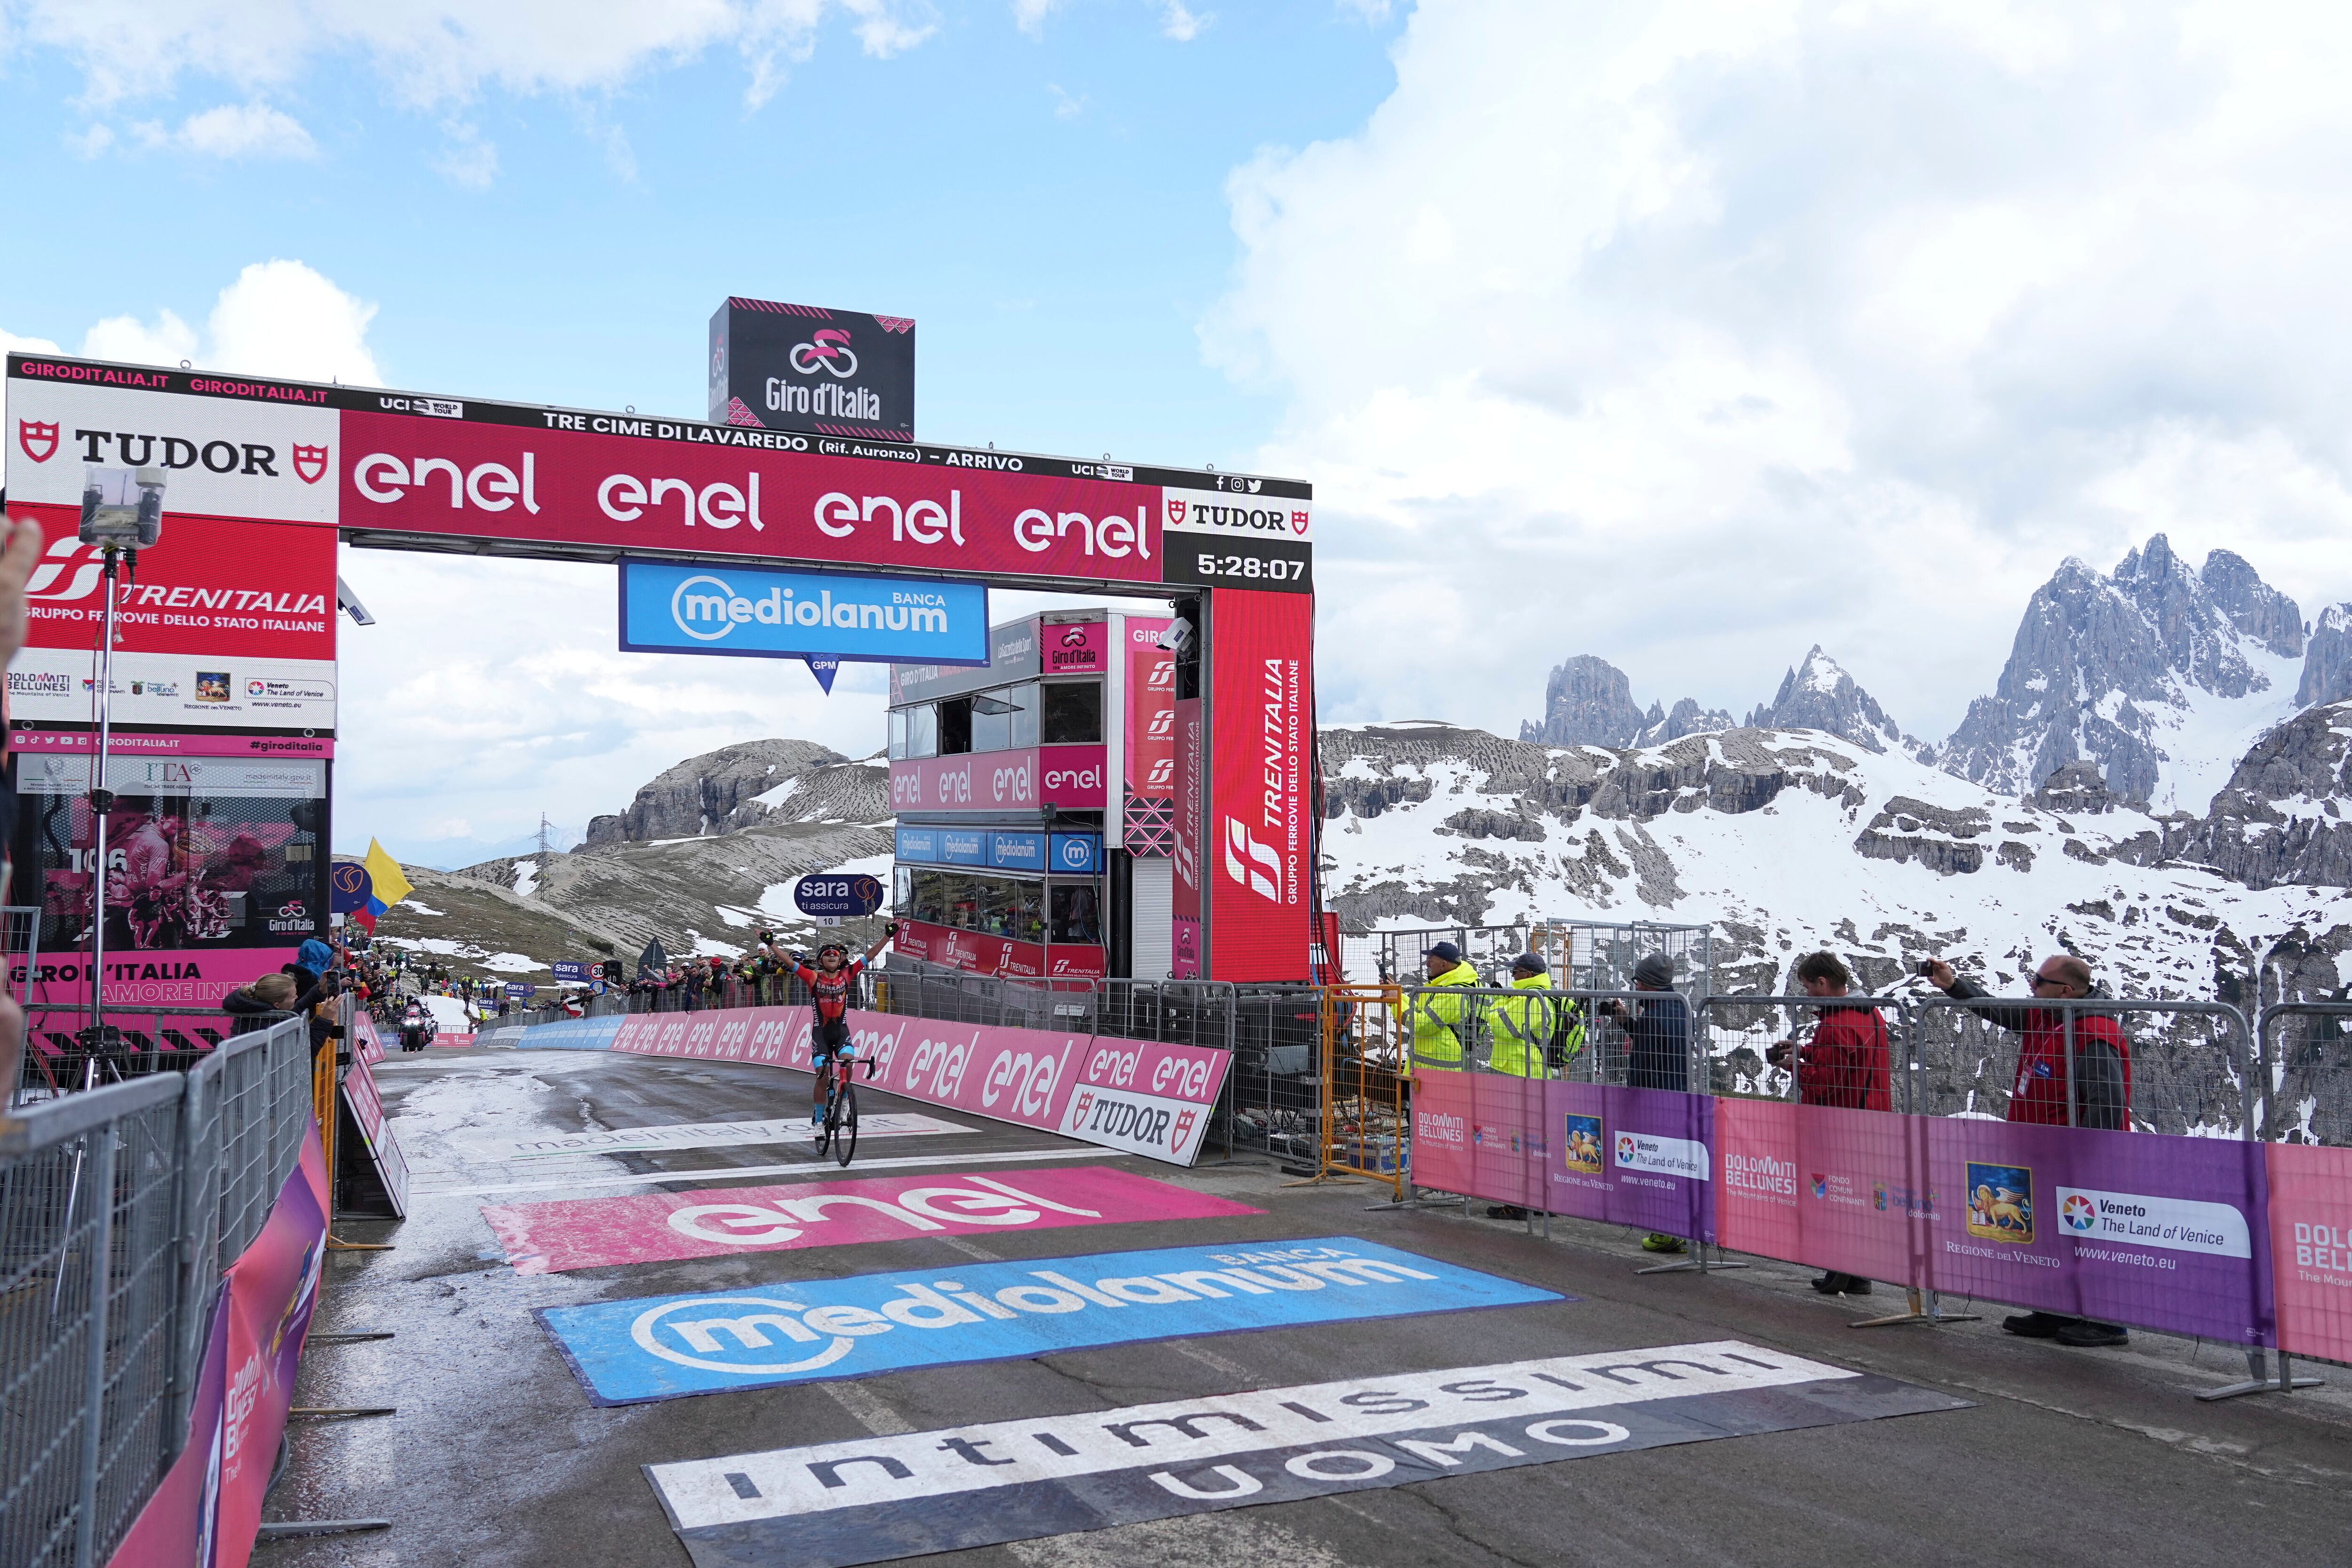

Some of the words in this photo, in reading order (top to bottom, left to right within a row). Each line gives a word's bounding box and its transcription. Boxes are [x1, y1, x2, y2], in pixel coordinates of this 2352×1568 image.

[21, 361, 169, 387] GIRODITALIA.IT
[191, 379, 327, 403] GIRODITALIA.IT
[380, 398, 410, 411] UCI
[766, 377, 810, 415] Giro
[813, 382, 880, 421] d'Italia
[75, 429, 279, 477] TUDOR
[543, 413, 586, 431] TRE
[592, 418, 652, 437] CIME
[658, 423, 682, 440] DI
[688, 425, 809, 452] LAVAREDO
[818, 440, 849, 455] (Rif.
[853, 444, 922, 463] Auronzo)
[946, 452, 1023, 471] ARRIVO
[1072, 464, 1094, 476] UCI
[354, 452, 541, 515] enel
[597, 472, 764, 532] enel
[814, 490, 965, 547] enel
[1193, 504, 1285, 531] TUDOR
[1014, 506, 1151, 560] enel
[1199, 555, 1304, 581] 5:28:07
[119, 584, 326, 614] TRENITALIA
[685, 587, 947, 633] mediolanum
[892, 592, 946, 607] BANCA
[165, 614, 209, 627] DELLO
[214, 617, 259, 630] STATO
[263, 619, 325, 633] ITALIANE
[1002, 641, 1015, 657] Gazzetta
[1023, 637, 1031, 654] Sport
[1053, 650, 1068, 664] Giro
[1070, 649, 1096, 663] d'Italia
[812, 661, 836, 670] GPM
[901, 670, 914, 687] GIRO
[914, 665, 938, 684] D'ITALIA
[1289, 660, 1298, 711] ITALIANE
[250, 741, 323, 751] #giroditalia
[1265, 659, 1282, 828] TRENITALIA
[1289, 715, 1298, 752] STATO
[894, 765, 921, 804] enel
[940, 761, 971, 803] enel
[993, 756, 1032, 802] enel
[1045, 764, 1101, 789] enel
[1289, 756, 1298, 791] DELLO
[1288, 796, 1298, 852] FERROVIE
[946, 838, 978, 854] mediolanum
[997, 840, 1035, 857] mediolanum
[801, 882, 848, 897] sara
[1288, 854, 1298, 904] GRUPPO
[270, 919, 286, 931] Giro
[288, 919, 314, 931] d'Italia
[908, 938, 926, 949] TRENITALIA
[955, 949, 976, 962] TRENITALIA
[1010, 962, 1035, 975] TRENITALIA
[817, 980, 846, 990] BAHRAIN
[613, 1017, 643, 1048] enel
[634, 1016, 664, 1051] enel
[657, 1015, 688, 1052] enel
[685, 1014, 721, 1055] enel
[715, 1012, 754, 1057] enel
[749, 1011, 793, 1059] enel
[906, 1032, 979, 1100] enel
[1089, 1044, 1144, 1085] enel
[1152, 1052, 1217, 1098] enel
[983, 1040, 1073, 1119] enel
[1090, 1098, 1170, 1145] TUDOR
[1418, 1112, 1463, 1130] DOLOMITI
[1419, 1125, 1463, 1142] BELLUNESI
[1427, 1139, 1443, 1149] Mountains
[1637, 1139, 1658, 1152] Veneto
[1637, 1153, 1646, 1164] The
[1648, 1155, 1665, 1167] Land
[1668, 1156, 1674, 1168] of
[1676, 1159, 1697, 1172] Venice
[1725, 1154, 1796, 1178] DOLOMITI
[1554, 1173, 1580, 1186] REGIONE
[1590, 1178, 1613, 1191] VENETO
[1621, 1173, 1675, 1191] www.veneto.eu
[1726, 1170, 1796, 1195] BELLUNESI
[1828, 1175, 1849, 1184] FONDO
[1829, 1185, 1852, 1195] COMUNI
[667, 1176, 1102, 1245] enel
[1726, 1188, 1737, 1197] The
[1738, 1189, 1767, 1203] Mountains
[1769, 1195, 1776, 1203] of
[1777, 1196, 1796, 1207] Venice
[1830, 1195, 1864, 1206] CONFINANTI
[2100, 1200, 2145, 1217] Veneto
[1908, 1210, 1940, 1221] dolomiti
[2102, 1218, 2124, 1233] The
[2130, 1222, 2159, 1237] Land
[2163, 1226, 2177, 1239] of
[2180, 1229, 2224, 1246] Venice
[1206, 1248, 1359, 1265] BANCA
[1947, 1241, 1994, 1259] REGIONE
[2013, 1250, 2060, 1268] VENETO
[2074, 1246, 2176, 1270] www.veneto.eu
[2299, 1271, 2320, 1283] The
[669, 1258, 1440, 1353] mediolanum
[1146, 1418, 1631, 1500] UOMO
